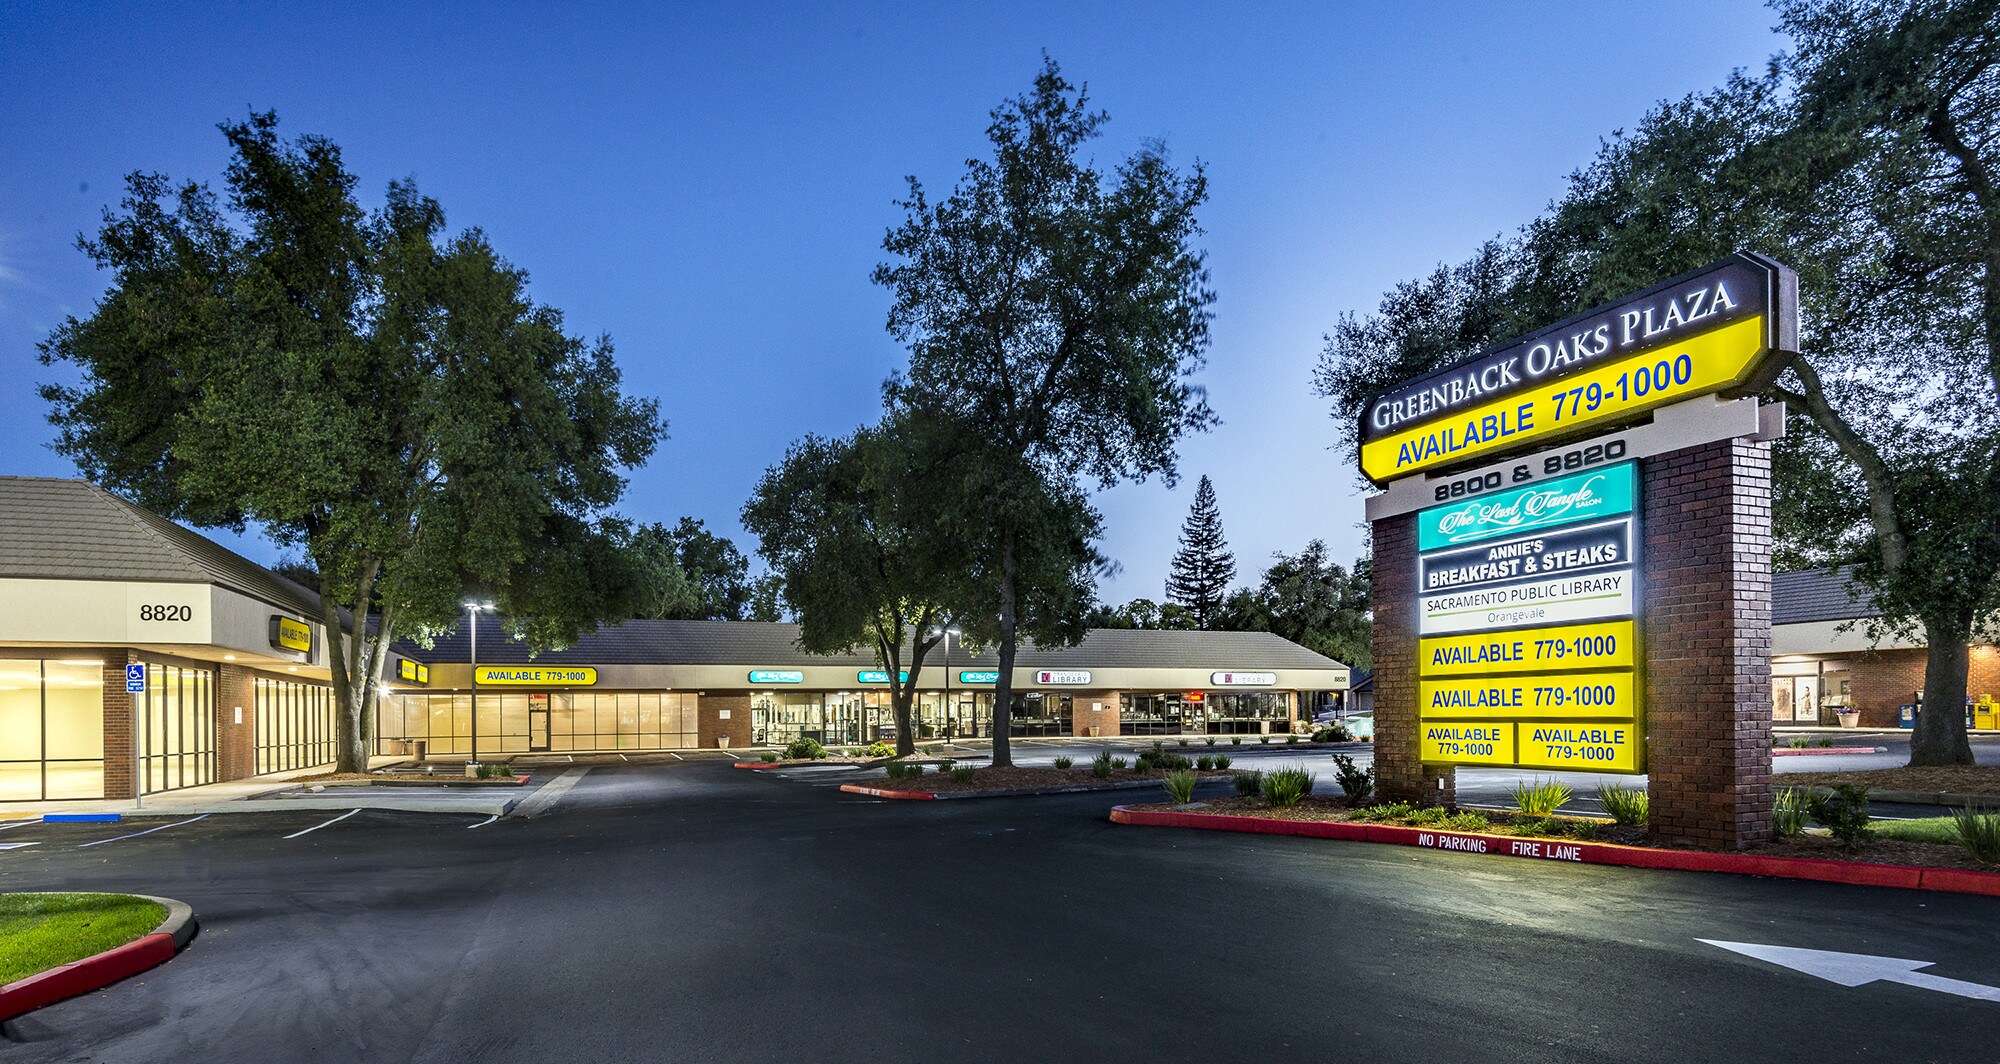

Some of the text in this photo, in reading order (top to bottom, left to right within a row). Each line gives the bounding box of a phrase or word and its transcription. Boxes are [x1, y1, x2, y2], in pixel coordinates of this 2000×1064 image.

[1373, 281, 1737, 429] GREENBACK OAKS PLAZA
[1397, 353, 1692, 468] AVAILABLE 779-1000
[1434, 439, 1626, 501] 8800 & 8820
[1438, 476, 1605, 535] The Last Tangle
[1575, 497, 1602, 509] SALON
[1488, 540, 1544, 561] ANNIE'S
[1429, 543, 1617, 588] BREAKFAST & STEAKS
[1427, 576, 1622, 612] SACRAMENTO PUBLIC LIBRARY
[140, 604, 192, 622] 8820
[1488, 607, 1545, 624] Orangevale
[1432, 635, 1616, 666] AVAILABLE 779-1000
[487, 671, 586, 681] AVAILABLE 779-1000
[1432, 685, 1615, 708] AVAILABLE 779-1000
[1427, 728, 1501, 741] AVAILABLE
[1532, 729, 1625, 744] AVAILABLE
[1438, 742, 1493, 756] 779-1000
[1546, 745, 1615, 761] 779-1000
[1418, 833, 1487, 853] NO PARKING
[1512, 841, 1582, 861] FIRE LANE
